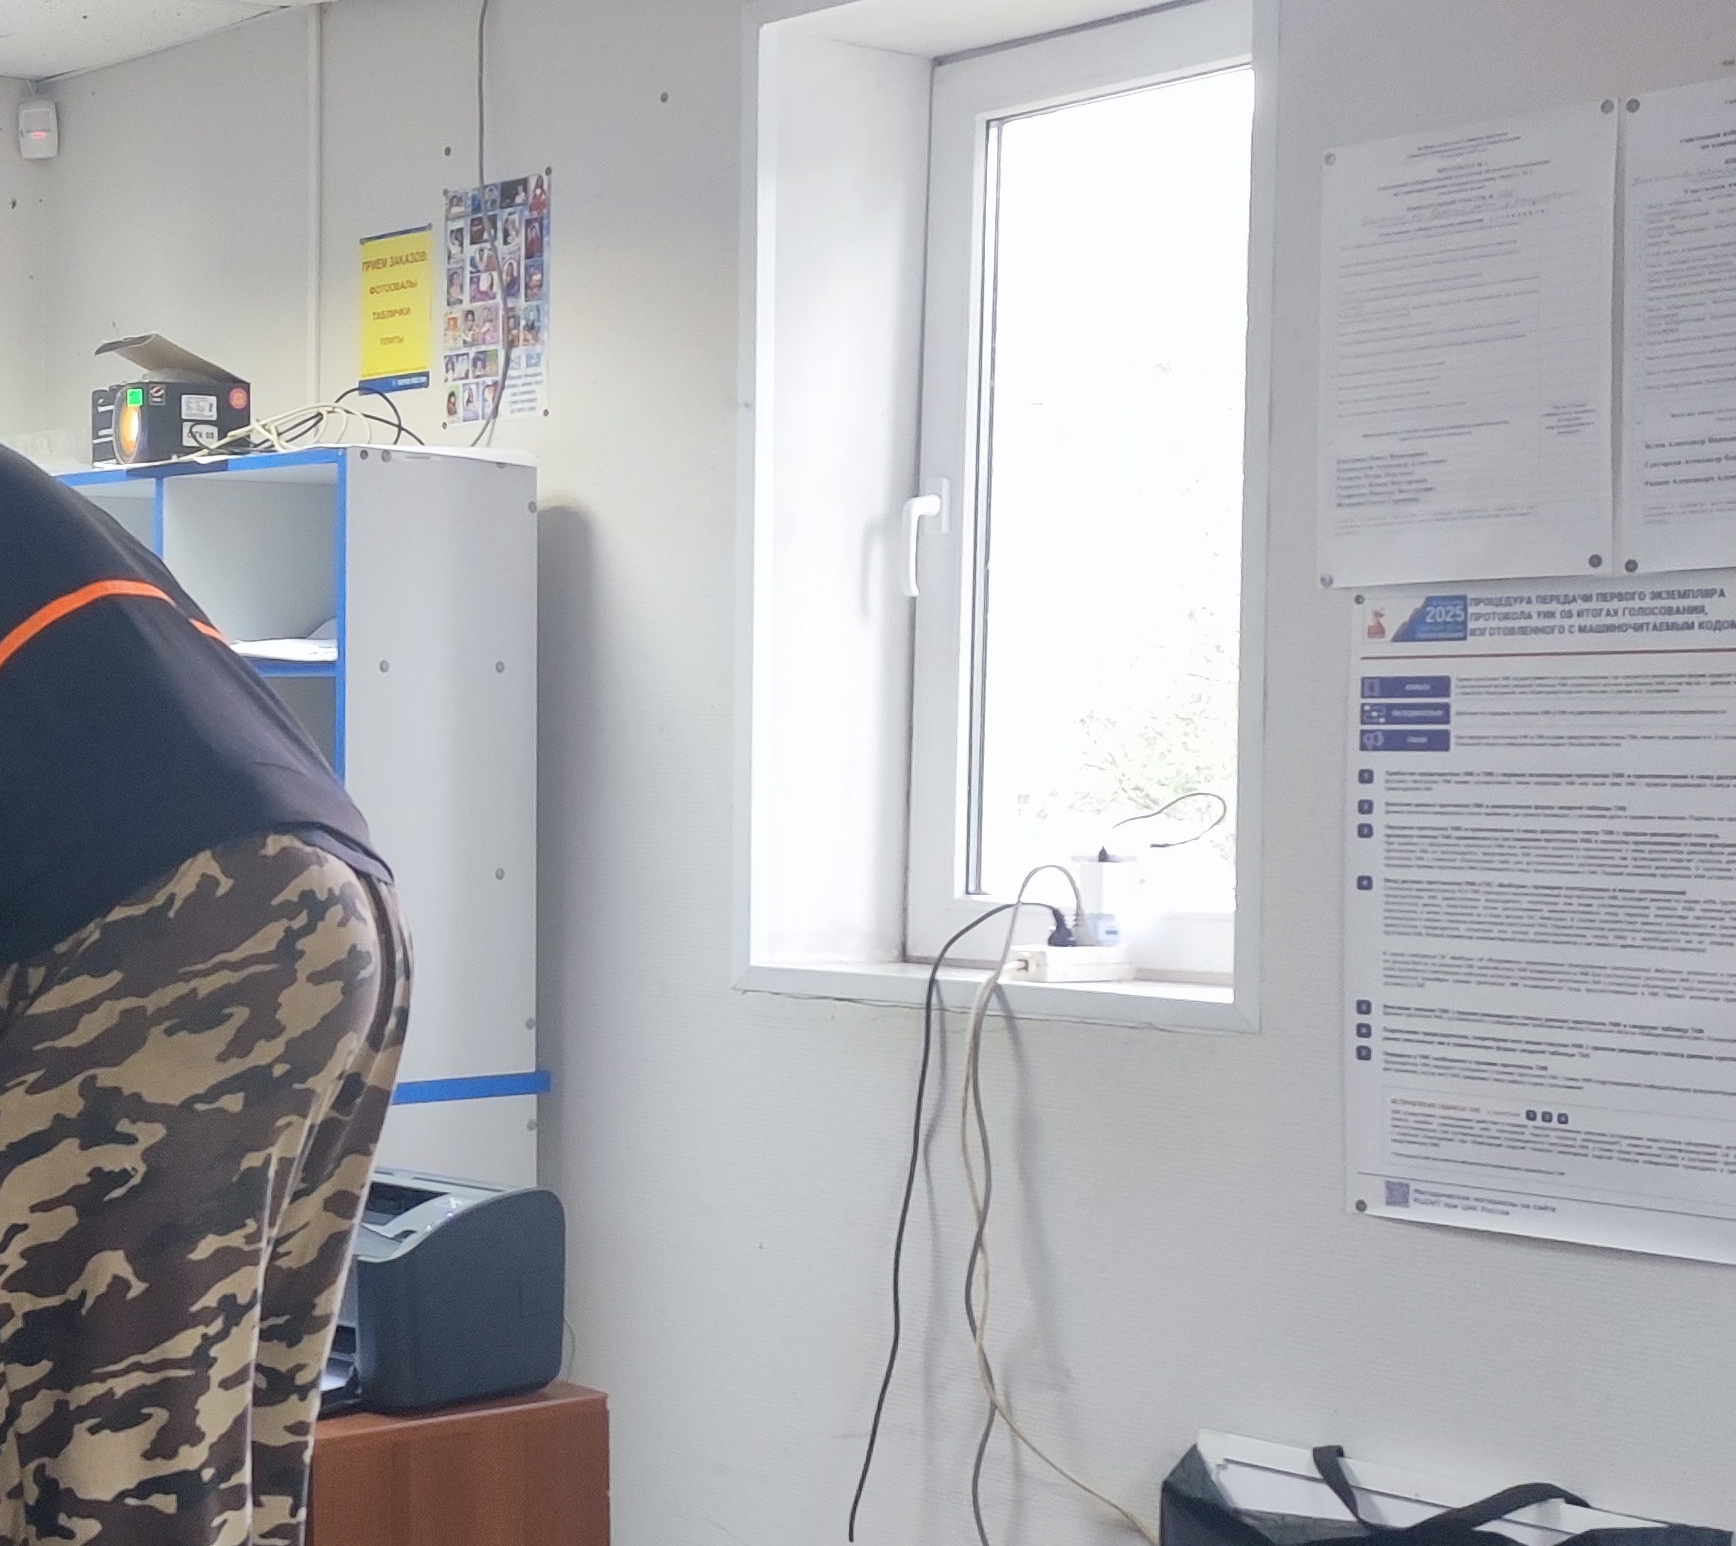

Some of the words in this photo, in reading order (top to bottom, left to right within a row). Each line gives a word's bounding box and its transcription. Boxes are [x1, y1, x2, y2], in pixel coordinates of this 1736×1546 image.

[1469, 595, 1533, 608] ПРОЦЕДУРА
[1535, 592, 1593, 606] ПЕРЕДАЧИ
[1596, 591, 1646, 603] ПЕРВОГО
[1649, 588, 1726, 601] ЭКЗЕМПЛЯРА
[1425, 605, 1465, 623] 2025
[1469, 610, 1533, 622] ПРОТОКОЛА
[1559, 608, 1574, 619] ОБ
[1576, 607, 1619, 619] ИТОГАХ
[1469, 624, 1565, 637] ИЗГОТОВЛЕННОГО
[1568, 624, 1576, 635] С
[1578, 620, 1695, 634] МАШИНОЧИТАЕМЫМ
